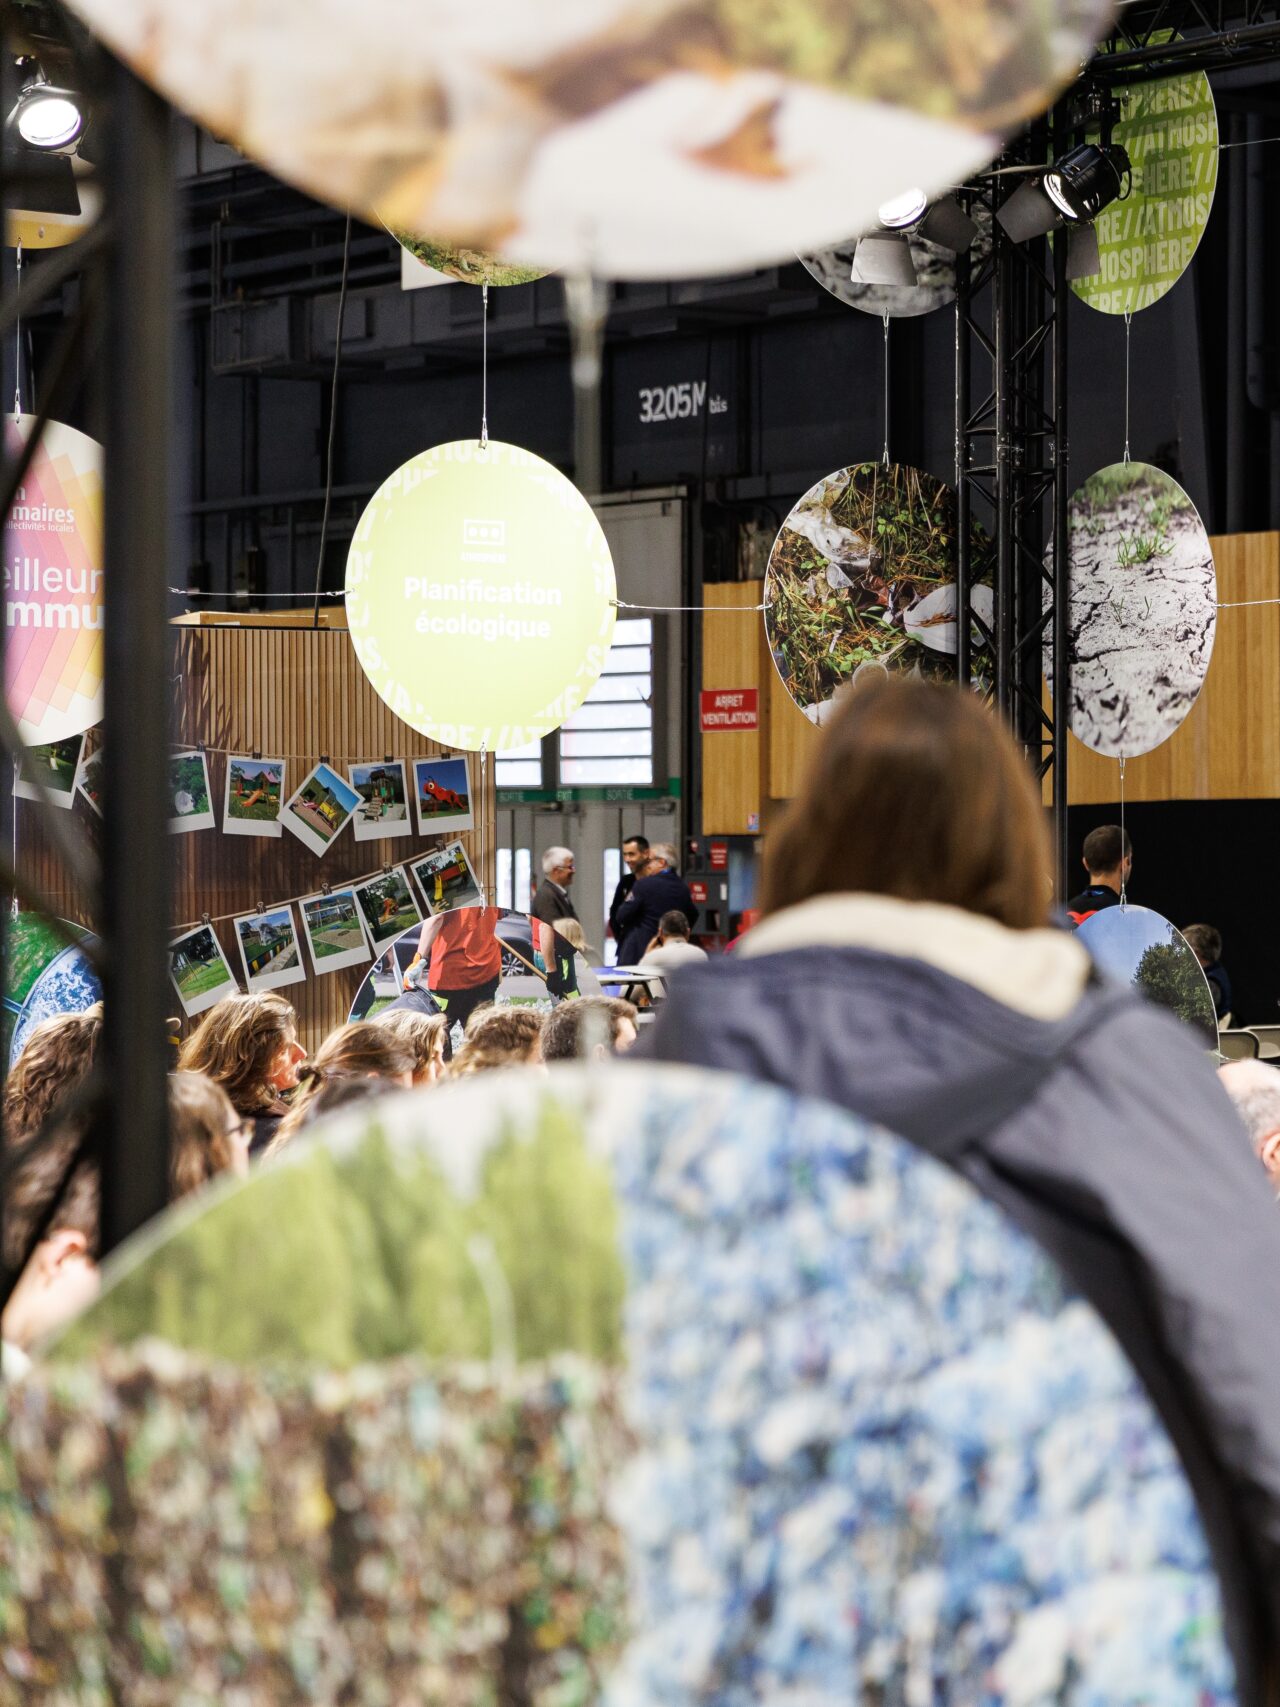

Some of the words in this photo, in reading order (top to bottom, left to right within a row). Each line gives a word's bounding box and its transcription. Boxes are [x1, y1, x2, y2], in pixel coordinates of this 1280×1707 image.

[709, 394, 728, 414] bis
[12, 503, 75, 523] maires
[4, 521, 46, 531] llectivités
[48, 522, 74, 533] locales
[403, 576, 562, 605] Planification
[6, 601, 104, 630] mmu
[415, 609, 552, 640] écologique
[703, 712, 757, 725] VENTILATION
